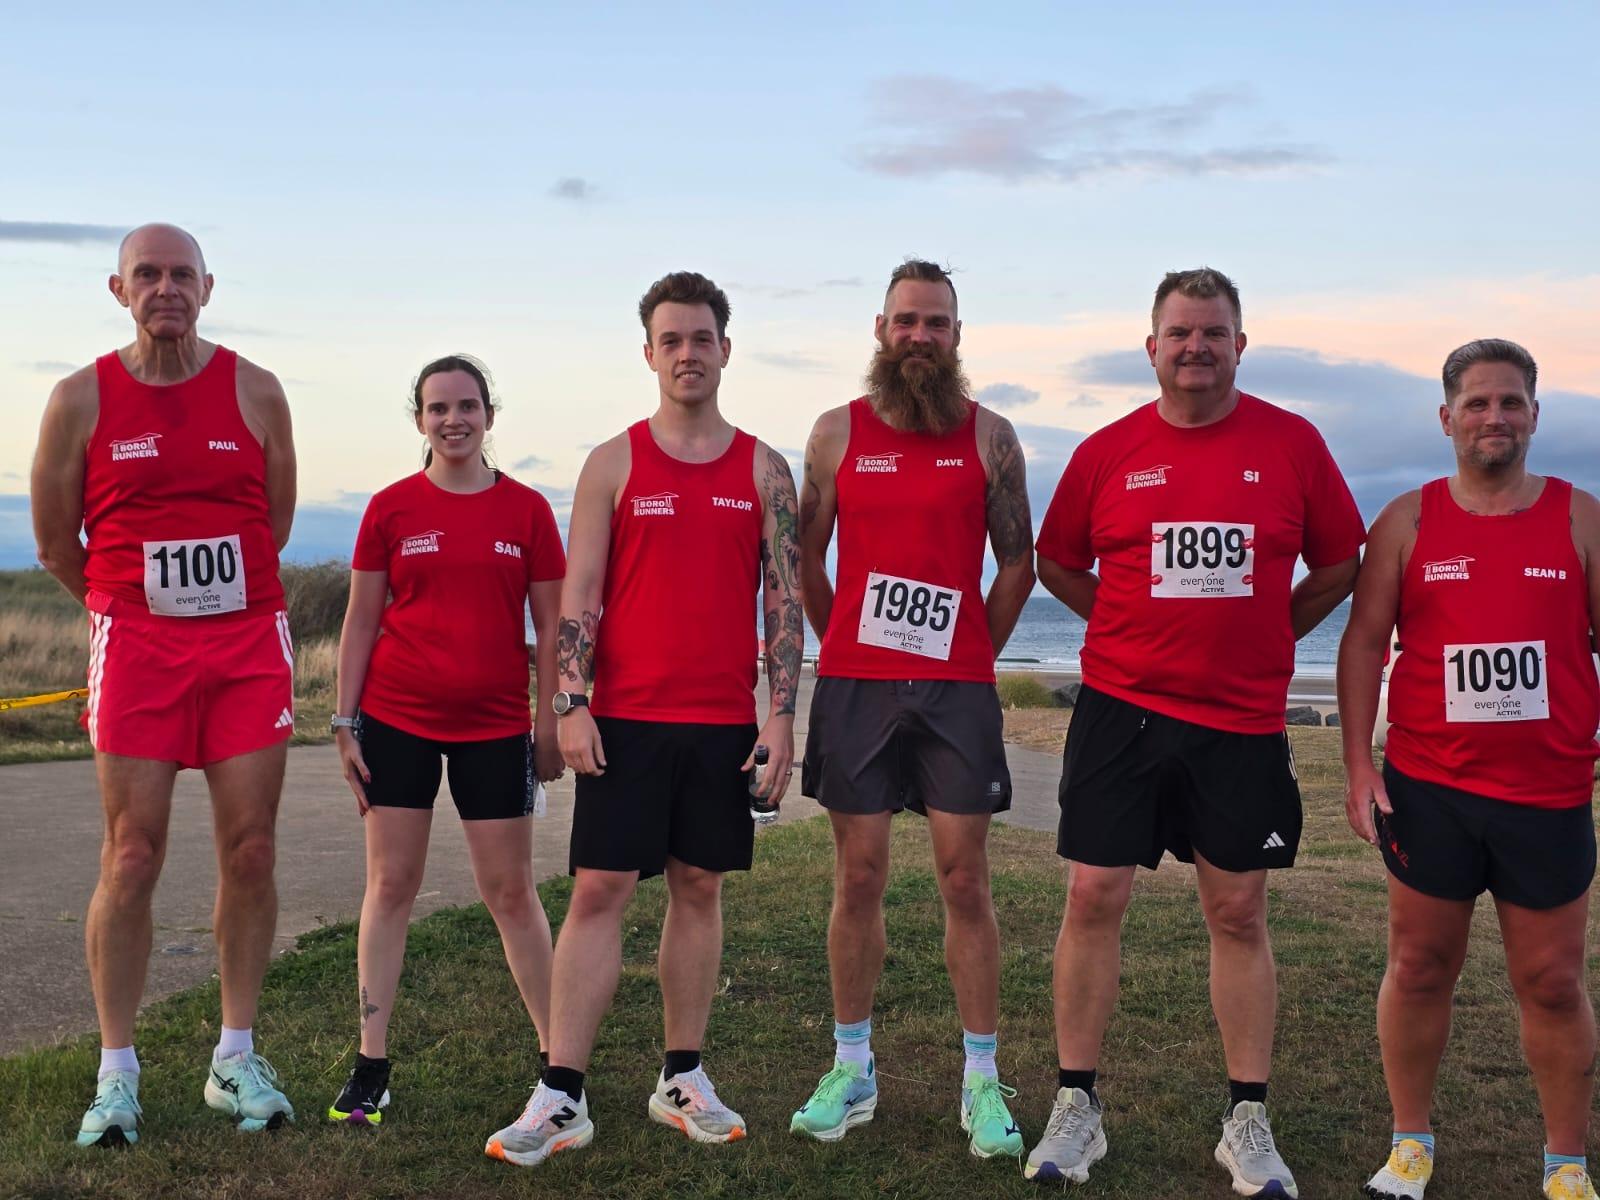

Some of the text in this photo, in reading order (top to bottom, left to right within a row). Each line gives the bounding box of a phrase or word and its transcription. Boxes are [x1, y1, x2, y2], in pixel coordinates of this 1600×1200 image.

[120, 441, 147, 452] BORO
[208, 440, 239, 451] PAUL
[112, 449, 159, 461] RUNNERS
[863, 458, 889, 466] BORO
[936, 458, 964, 467] DAVE
[855, 465, 898, 473] RUNNERS
[1133, 472, 1158, 482] BORO
[1243, 470, 1260, 483] SI
[1125, 478, 1167, 491] RUNNERS
[639, 500, 665, 508] BORO
[711, 496, 753, 511] TAYLOR
[633, 507, 675, 516] RUNNERS
[407, 538, 430, 547] BORO
[1162, 526, 1247, 569] 1899
[401, 545, 439, 557] RUNNERS
[494, 540, 521, 559] SAM
[152, 541, 236, 589] 1100
[1432, 564, 1459, 573] BORO
[1180, 572, 1225, 587] everyone
[1424, 572, 1470, 583] RUNNERS
[1523, 567, 1567, 580] SEAN B
[175, 590, 221, 605] everyone
[197, 603, 221, 611] ACTIVE
[869, 579, 953, 632] 1985
[883, 628, 925, 644] everyone
[900, 641, 923, 651] ACTIVE
[1448, 646, 1541, 693] 1090
[1474, 694, 1521, 710] everyone
